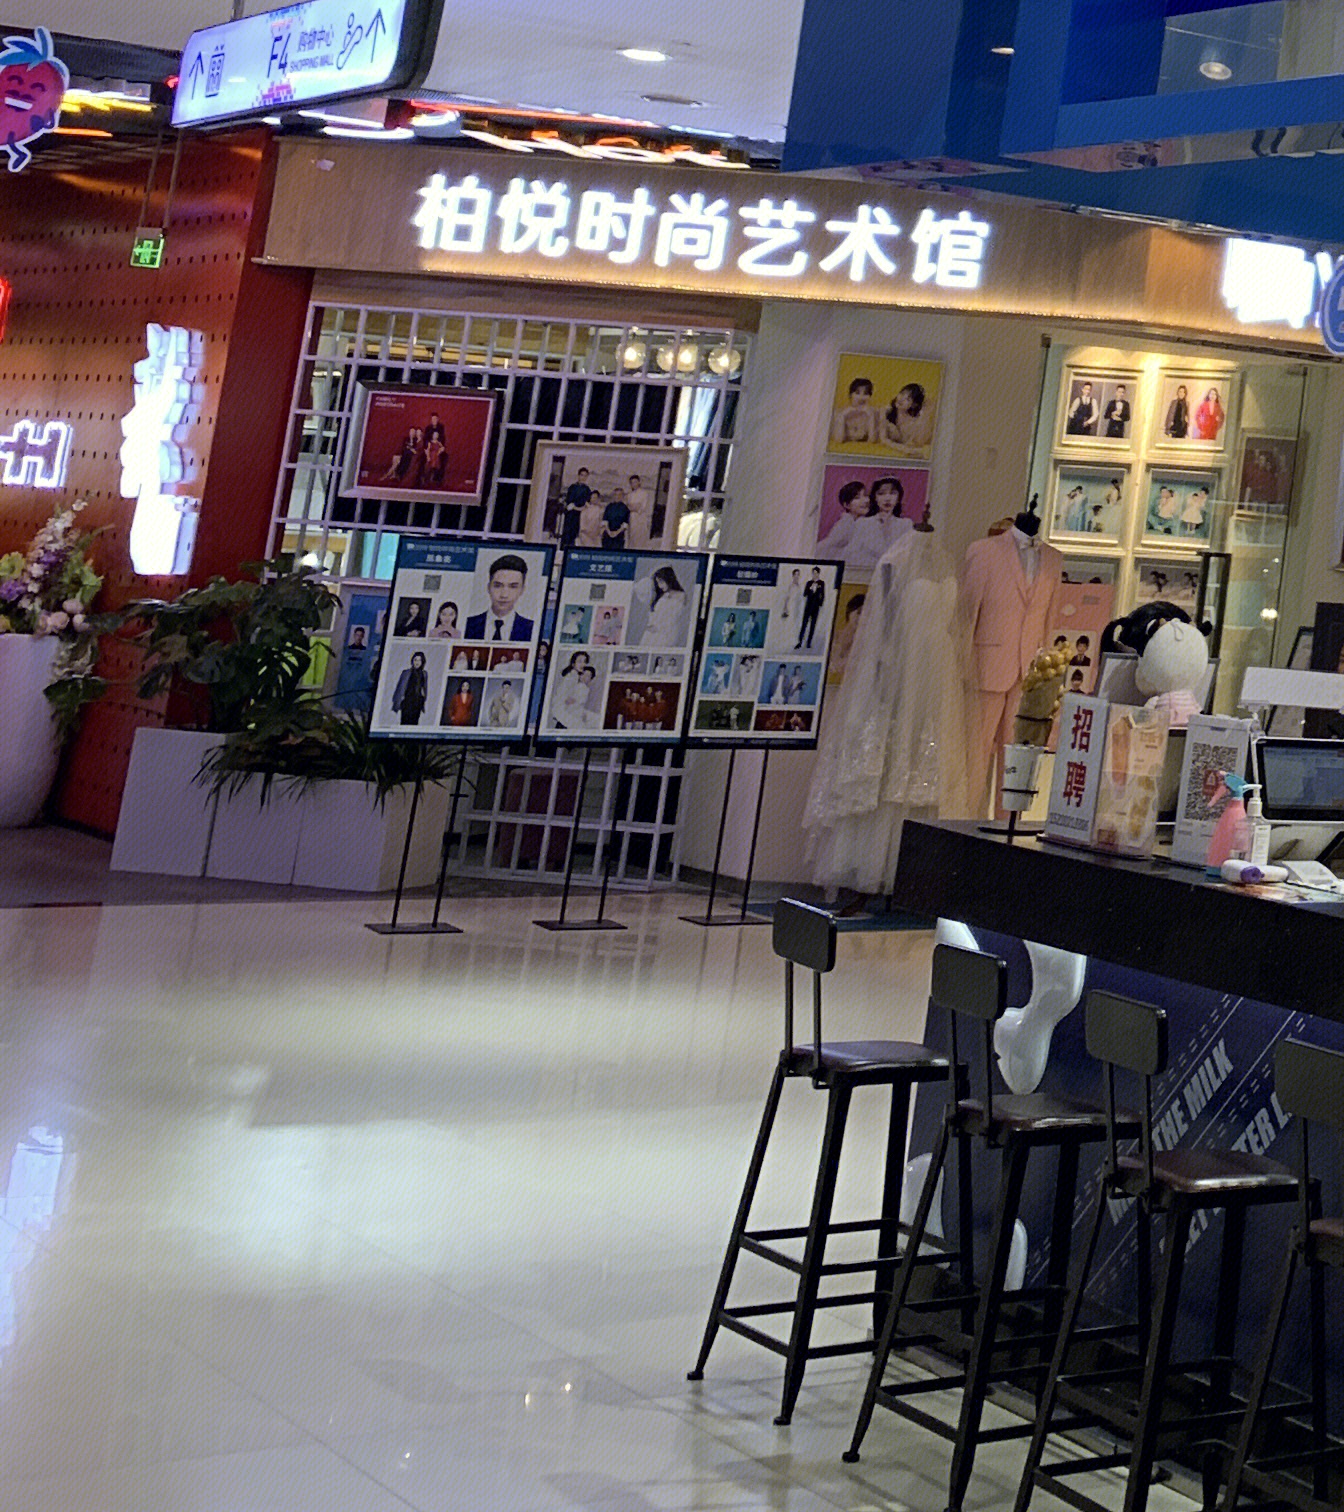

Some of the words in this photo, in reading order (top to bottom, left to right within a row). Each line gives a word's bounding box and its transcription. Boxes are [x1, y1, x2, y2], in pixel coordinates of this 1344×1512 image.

[267, 32, 291, 78] F4
[289, 57, 318, 73] SHOPPING
[318, 53, 334, 67] MALL
[298, 24, 334, 53] 购物中心
[414, 173, 991, 287] 柏悦时尚艺术馆
[1062, 704, 1094, 808] 招聘
[1152, 1100, 1189, 1151] THE
[1183, 1037, 1235, 1120] MILK
